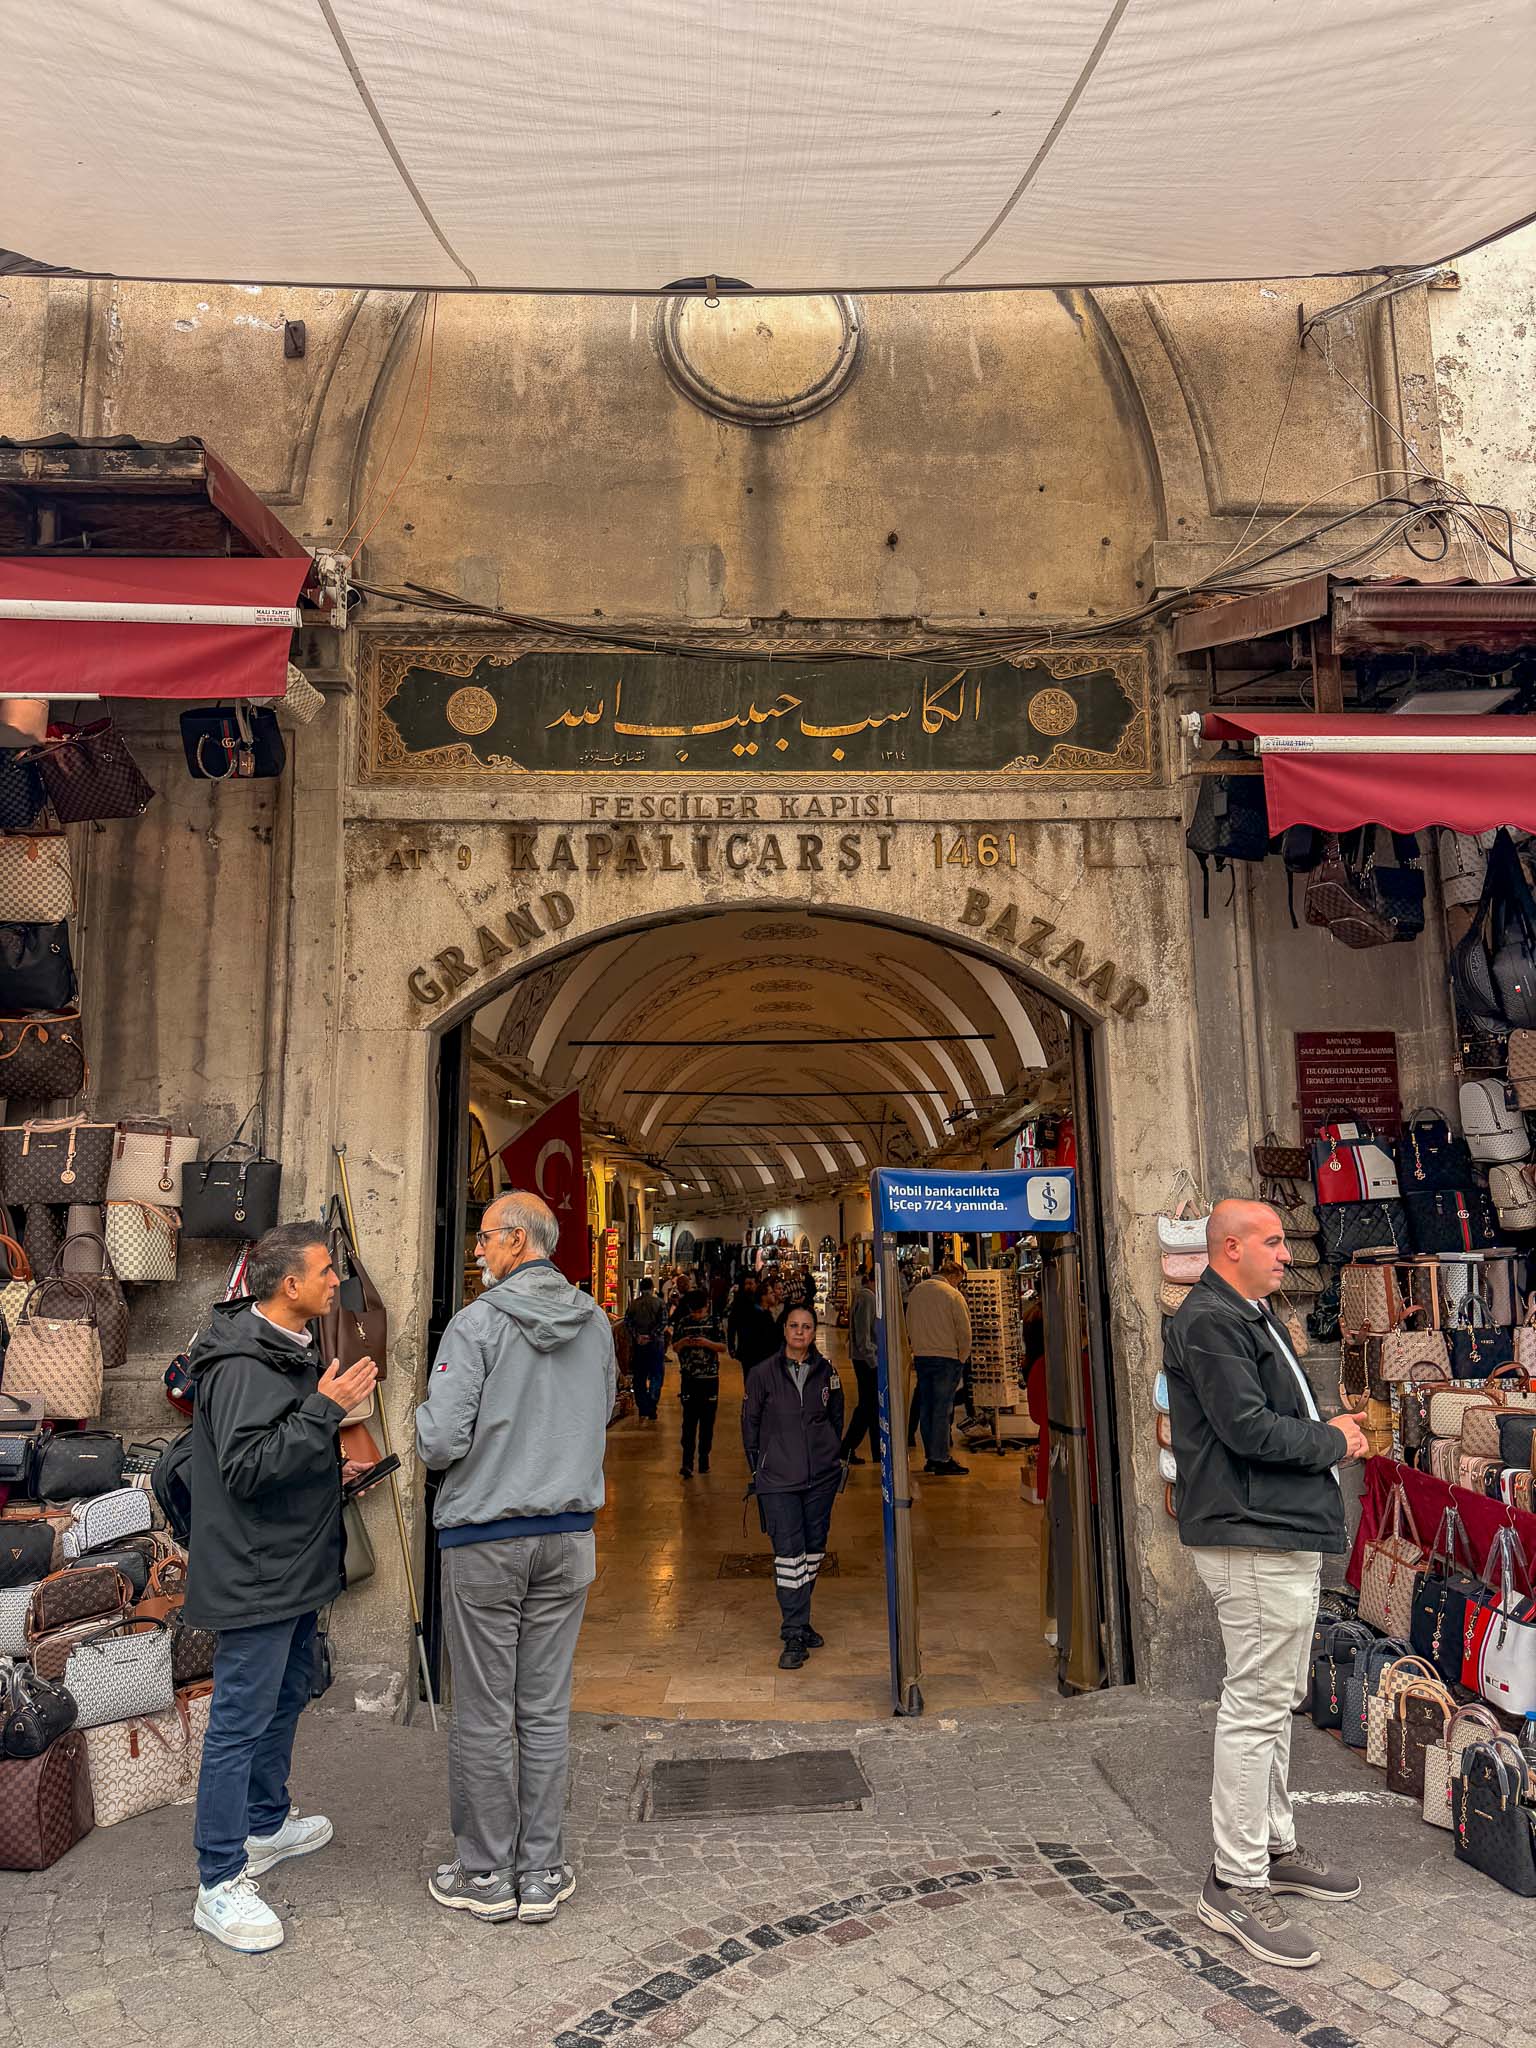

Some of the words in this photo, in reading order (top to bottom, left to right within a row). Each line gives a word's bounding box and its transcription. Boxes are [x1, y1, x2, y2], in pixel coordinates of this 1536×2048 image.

[544, 669, 622, 730] الله
[779, 795, 895, 818] KAPISI
[456, 844, 473, 871] 9
[931, 832, 1018, 869] 1461
[407, 890, 576, 1005] GRAND
[957, 886, 1150, 1023] BAZAAR
[888, 1185, 922, 1197] Mobil
[925, 1185, 1000, 1197] bankacılıkta
[889, 1198, 922, 1212] İşCep
[924, 1200, 952, 1211] 7/24
[954, 1200, 1008, 1213] yanında.
